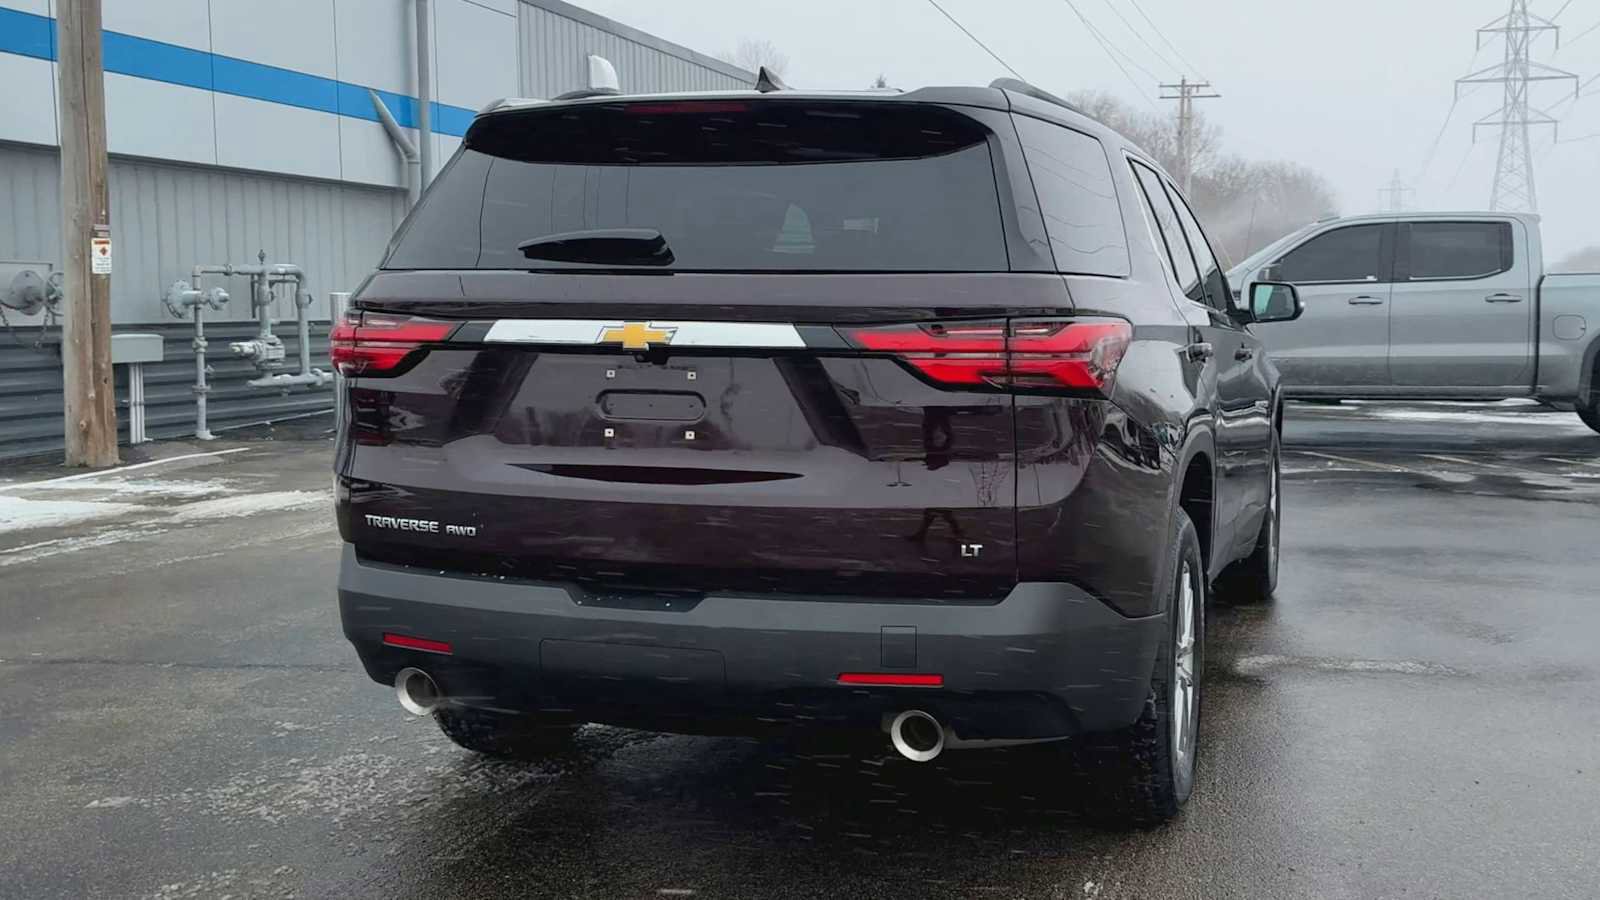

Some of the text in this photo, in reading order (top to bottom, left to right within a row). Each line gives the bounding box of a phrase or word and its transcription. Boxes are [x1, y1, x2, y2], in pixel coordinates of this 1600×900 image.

[365, 514, 477, 537] TRAVERSE AWD
[961, 544, 983, 557] LT
